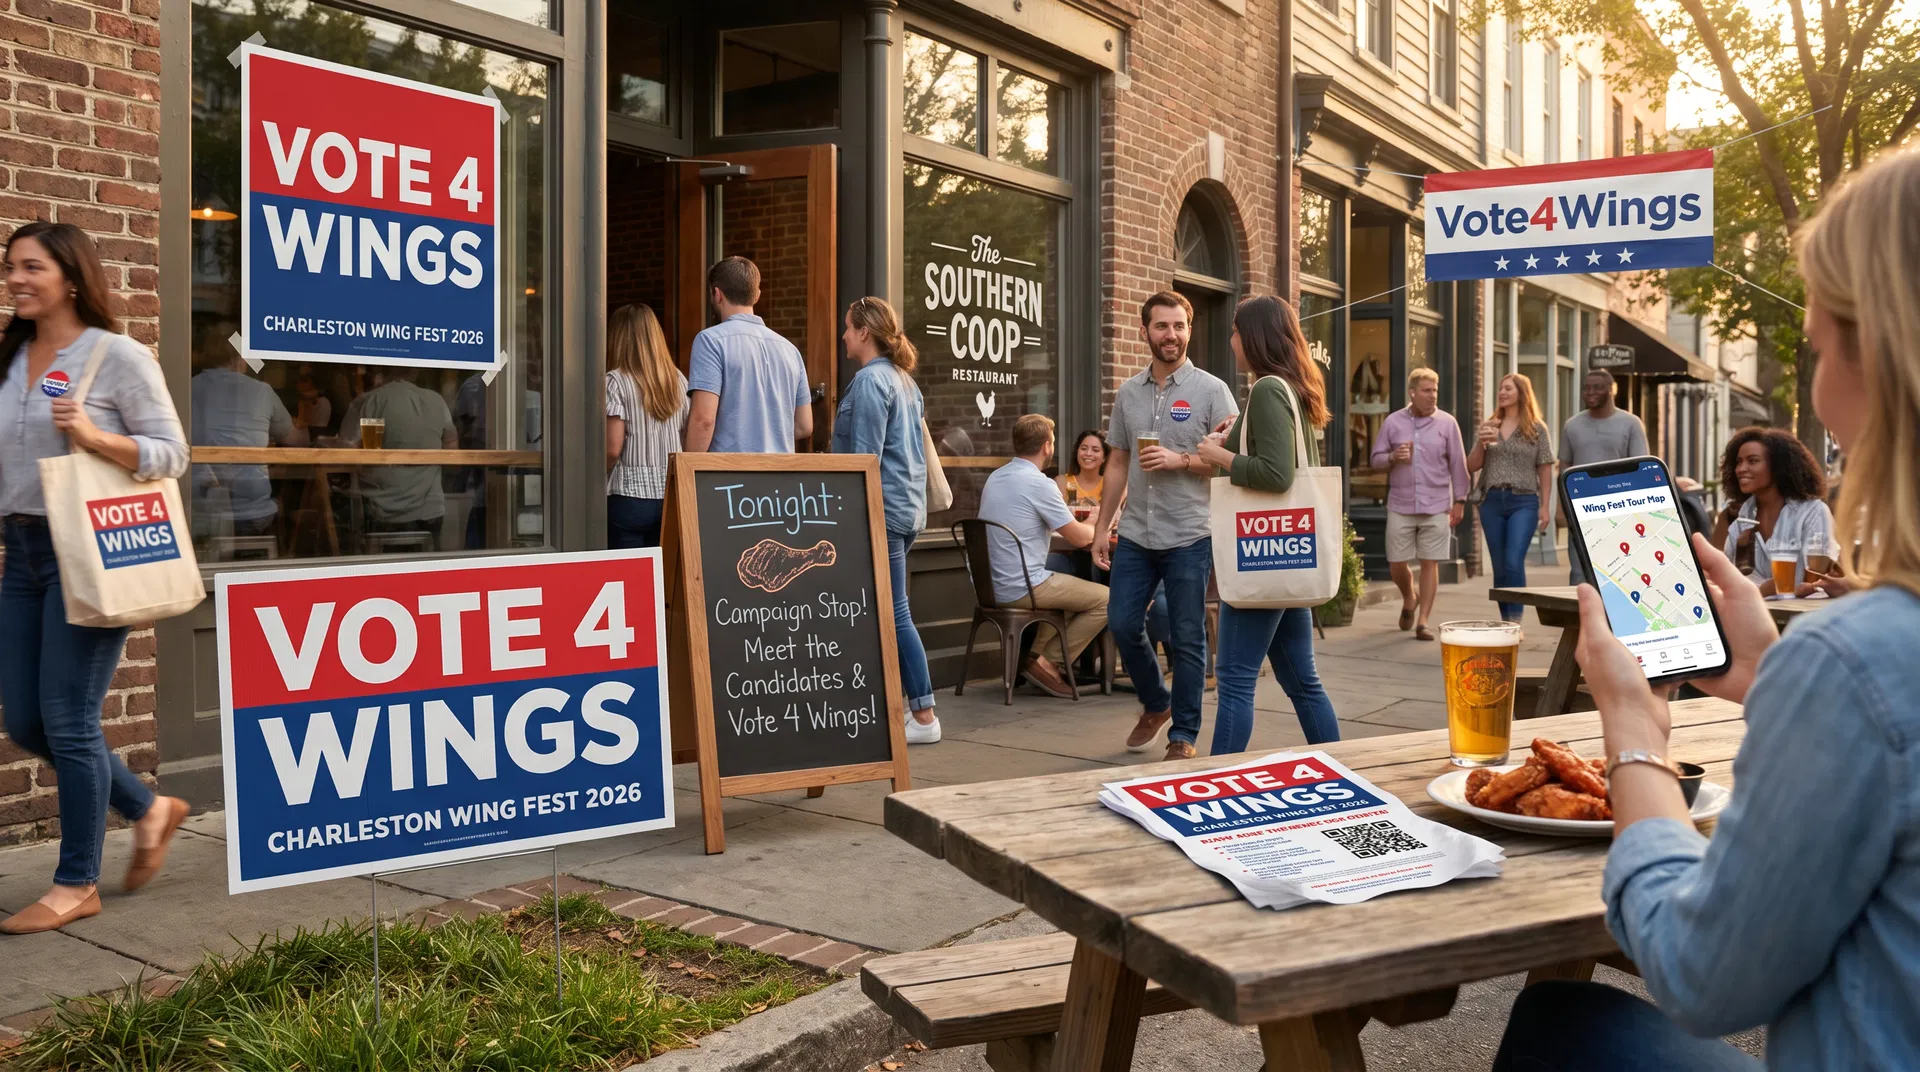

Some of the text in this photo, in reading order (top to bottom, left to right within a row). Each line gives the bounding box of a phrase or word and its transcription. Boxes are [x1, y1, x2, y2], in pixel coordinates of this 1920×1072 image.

[262, 120, 483, 213] VOTE 4
[1435, 190, 1701, 239] Vote4Wings
[262, 204, 483, 289] WINGS
[971, 234, 1002, 264] The
[924, 262, 1042, 328] SOUTHERN
[263, 315, 484, 345] CHARLESTON WING FEST 2026
[950, 312, 1021, 364] COOP
[952, 368, 1019, 385] RESTAURANT
[92, 500, 164, 527] VOTE 4
[714, 482, 843, 535] Tonight:
[1582, 494, 1666, 513] Wing Fest Tour Map
[100, 525, 172, 553] WINGS
[1240, 514, 1311, 535] VOTE 4
[1241, 536, 1312, 558] WINGS
[715, 587, 868, 633] Campaign Stop!
[254, 580, 635, 692] VOTE 4
[744, 633, 842, 663] Meet the
[726, 663, 866, 699] Candidates &
[728, 694, 877, 739] Vote 4 Wings!
[257, 681, 640, 806] WINGS
[1139, 763, 1325, 803] VOTE 4
[1163, 782, 1355, 824] WINGS
[267, 809, 442, 854] CHARLESTON
[448, 799, 516, 828] WING
[523, 791, 579, 817] FEST
[585, 782, 642, 809] 2026
[1192, 799, 1370, 833] CHARLESTON WING FEST 2026
